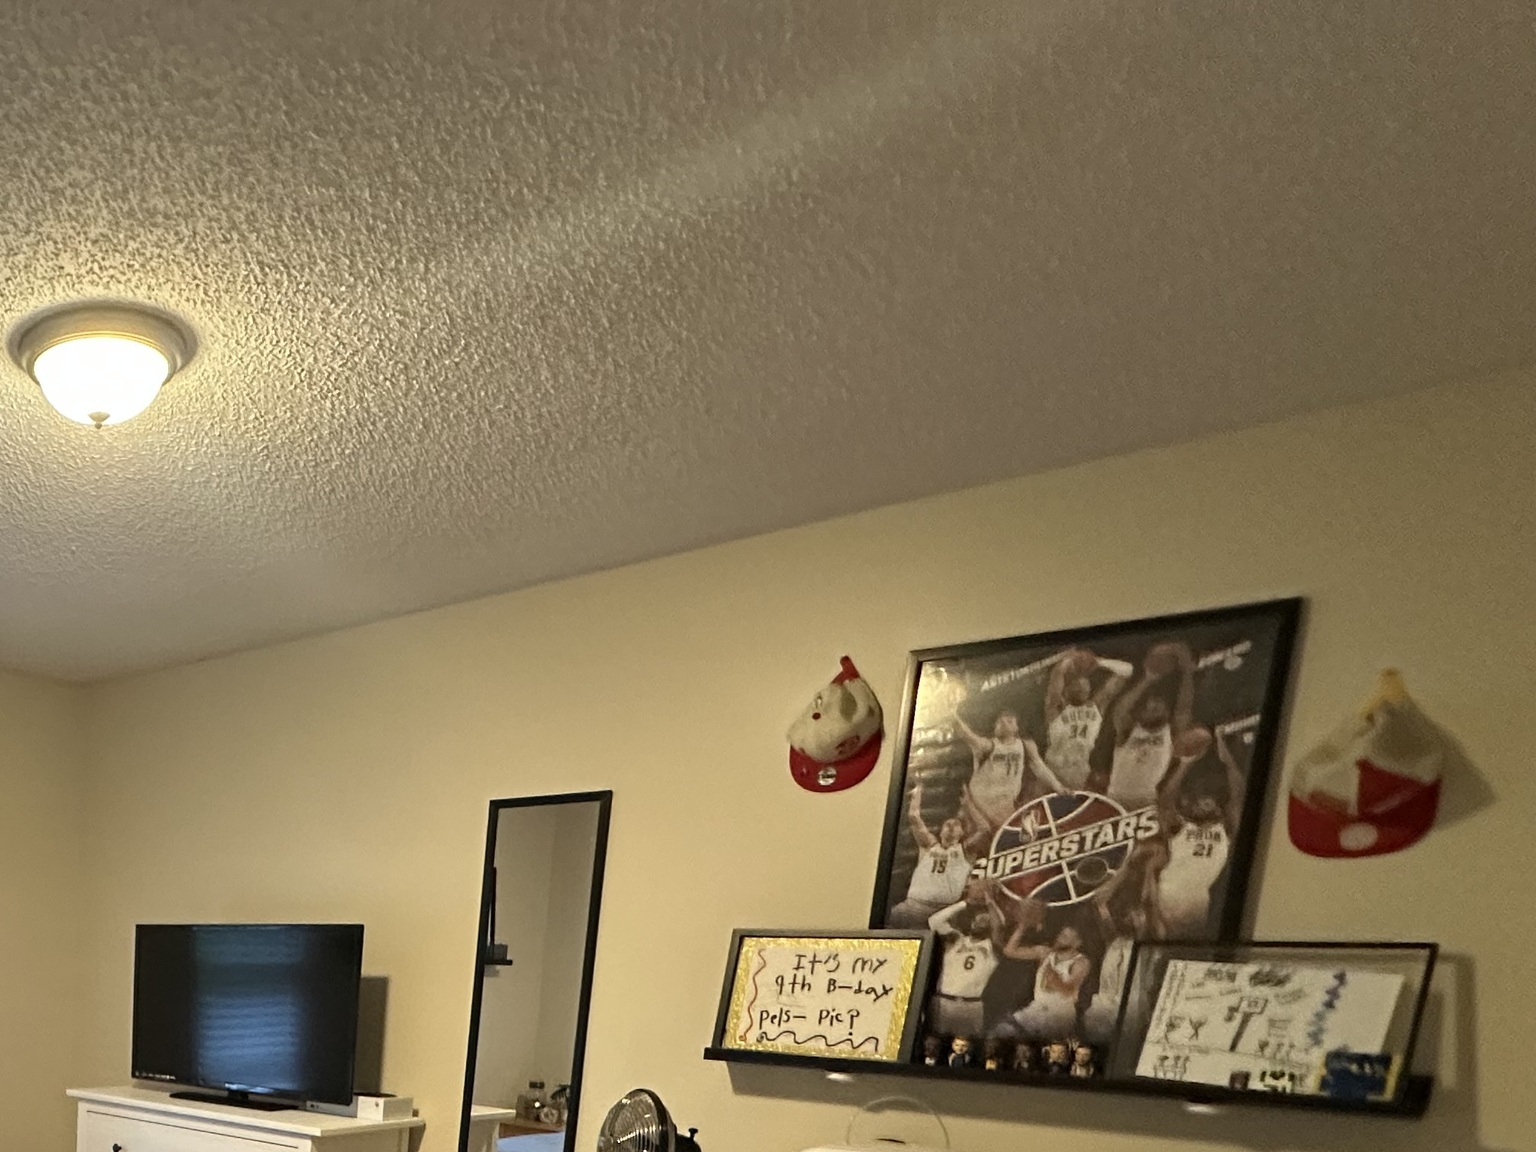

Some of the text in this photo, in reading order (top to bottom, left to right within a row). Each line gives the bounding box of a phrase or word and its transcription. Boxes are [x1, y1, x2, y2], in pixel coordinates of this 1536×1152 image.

[971, 809, 1160, 880] SUPERSTARS
[1192, 843, 1214, 859] 21
[931, 858, 948, 874] 15
[964, 956, 975, 970] 6
[775, 974, 894, 1002] 9th B-day
